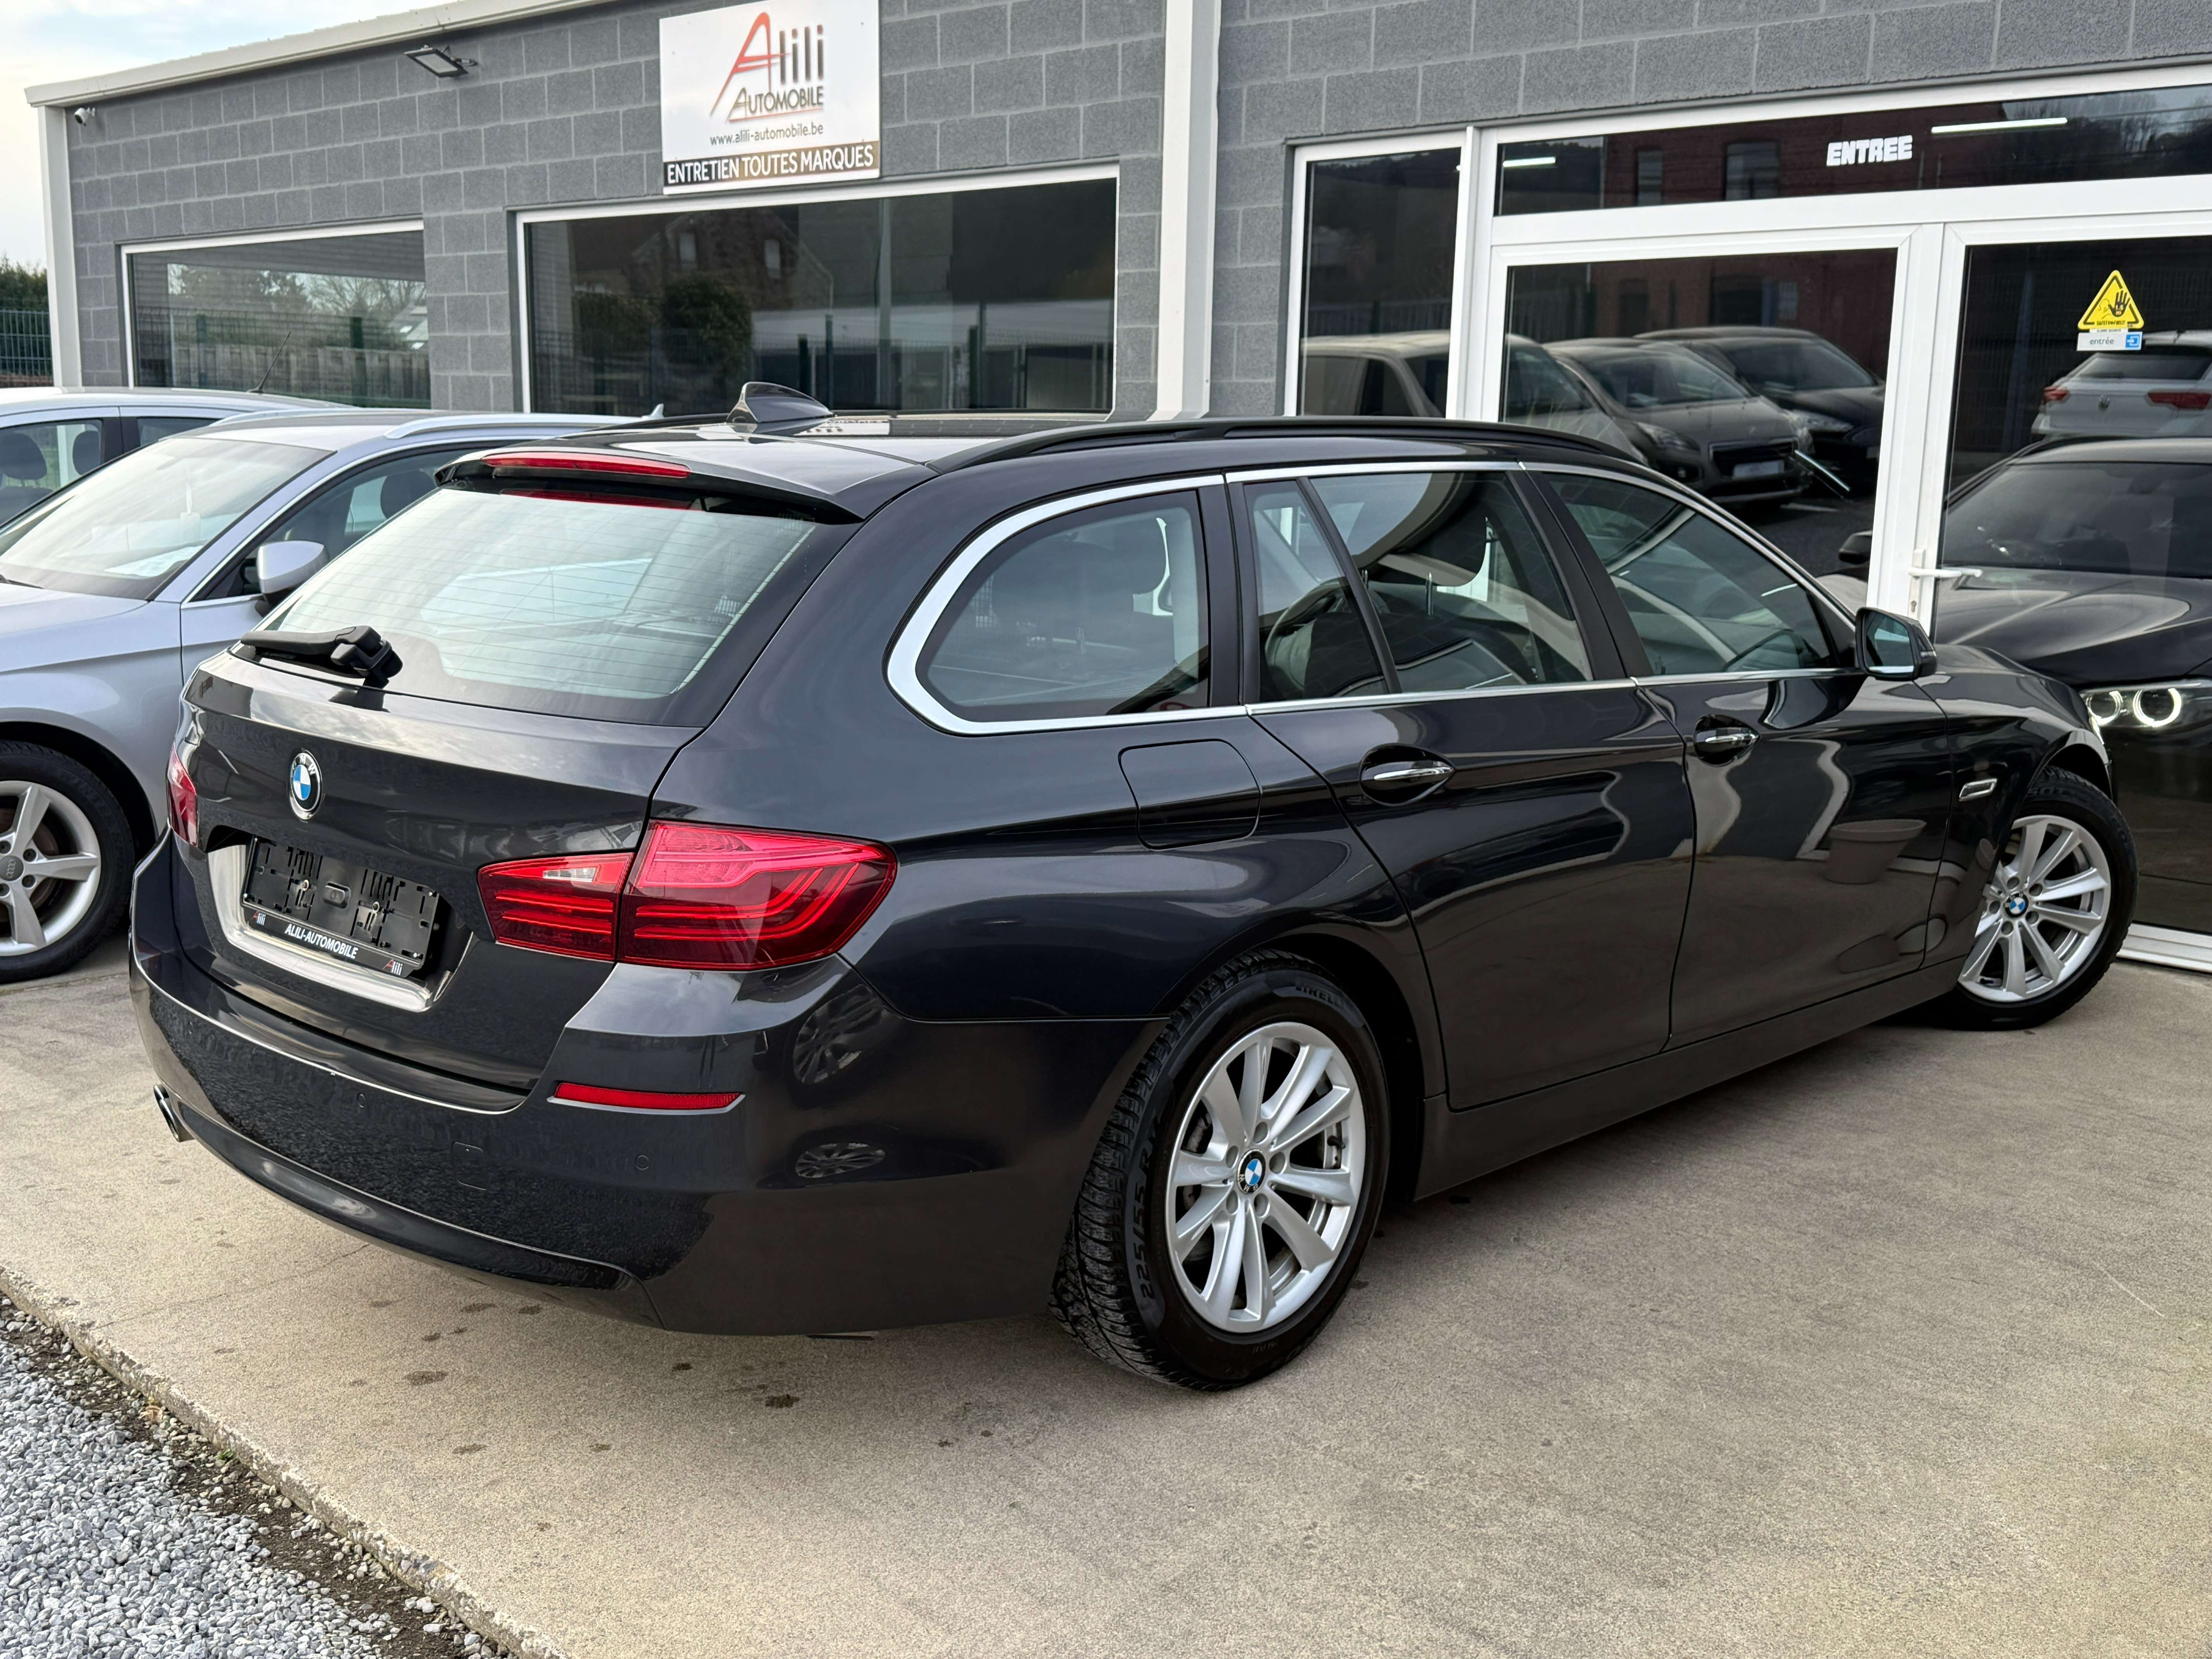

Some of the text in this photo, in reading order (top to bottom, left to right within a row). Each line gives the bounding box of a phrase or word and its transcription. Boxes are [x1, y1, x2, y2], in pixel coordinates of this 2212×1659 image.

[709, 11, 824, 117] Alili
[727, 86, 824, 122] AUTOMOBILE
[709, 122, 824, 146] www.alili-automobile.be
[667, 144, 874, 184] ENTRETIEN TOUTES MARQUES
[1826, 135, 1913, 167] ENTREE
[2090, 336, 2114, 345] entrée
[285, 923, 359, 959] ALILI-AUTOMOBILE
[382, 959, 403, 975] Alili
[1239, 1174, 1259, 1192] BMW
